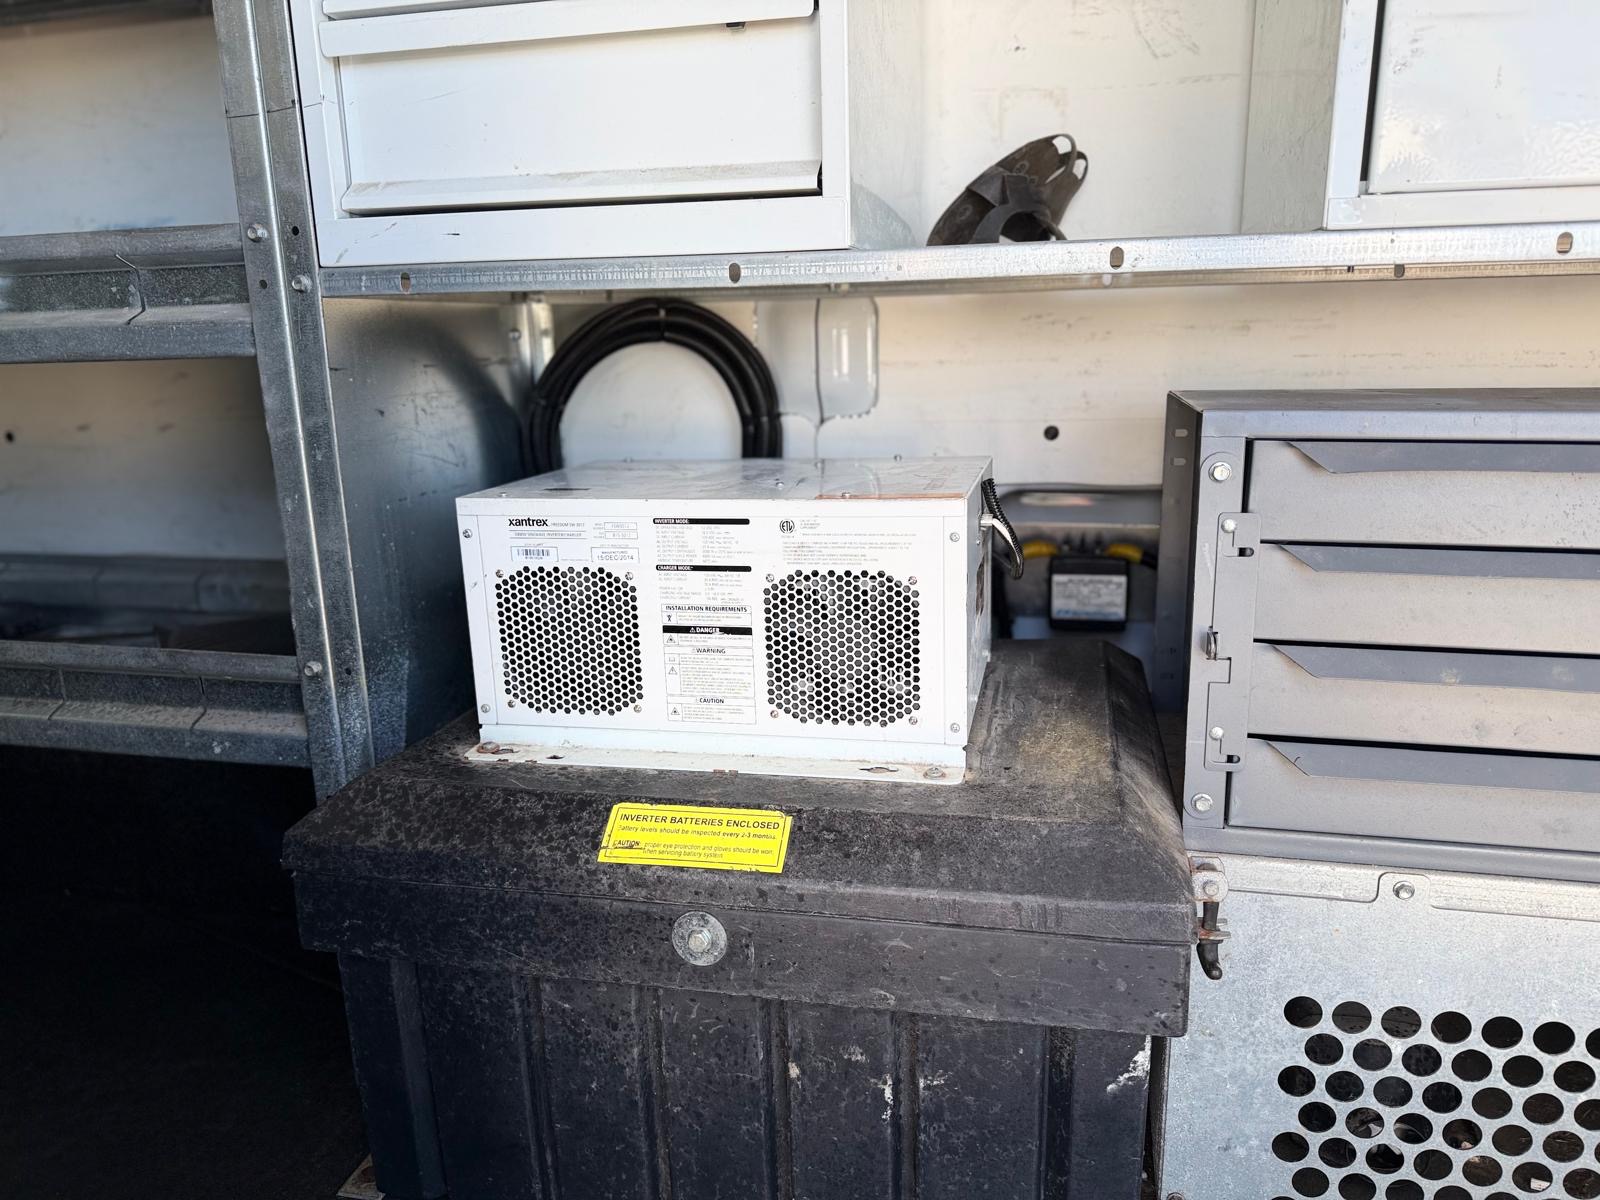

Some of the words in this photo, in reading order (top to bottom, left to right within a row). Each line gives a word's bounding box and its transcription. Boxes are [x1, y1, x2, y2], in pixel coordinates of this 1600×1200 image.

[508, 517, 549, 527] xantrex
[620, 813, 668, 823] INVERTER
[669, 816, 723, 826] BATTERIES
[726, 819, 780, 829] ENCLOSED
[640, 825, 658, 833] levels
[660, 826, 680, 834] should
[690, 828, 721, 837] inspected
[674, 843, 701, 851] protection
[658, 849, 682, 857] servicing
[683, 850, 702, 858] battery
